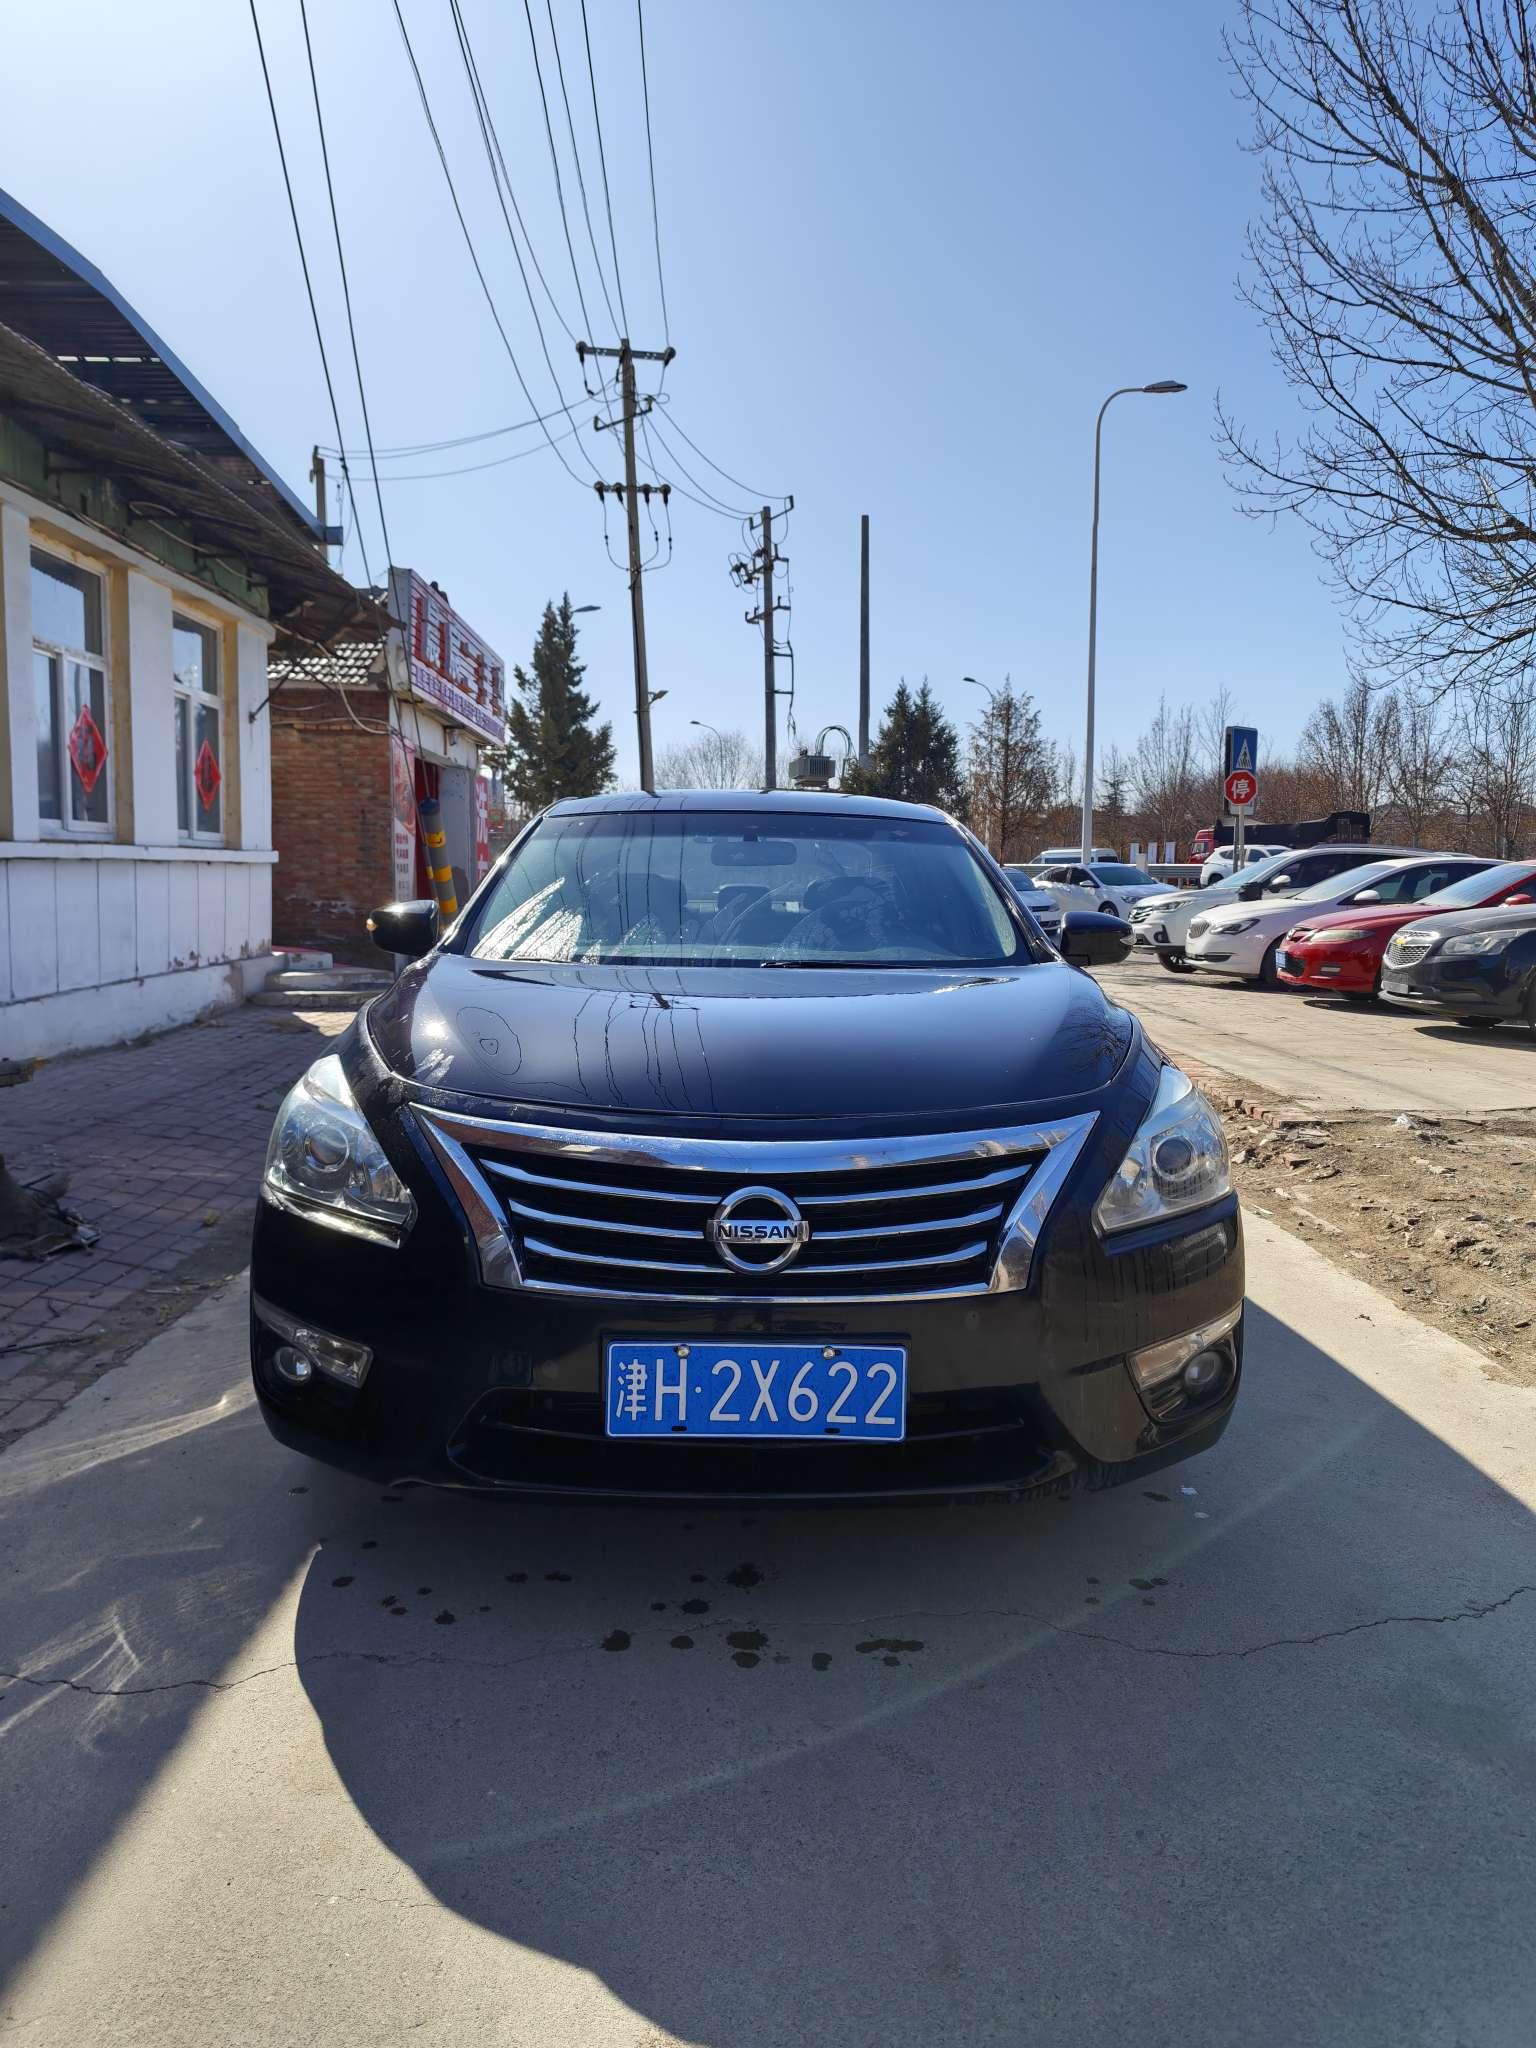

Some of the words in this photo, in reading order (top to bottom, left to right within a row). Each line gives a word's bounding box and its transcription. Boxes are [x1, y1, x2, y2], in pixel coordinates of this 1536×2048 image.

[1231, 779, 1250, 799] 停
[717, 1225, 798, 1239] NISSAN
[615, 1358, 898, 1425] 津H·2X622
